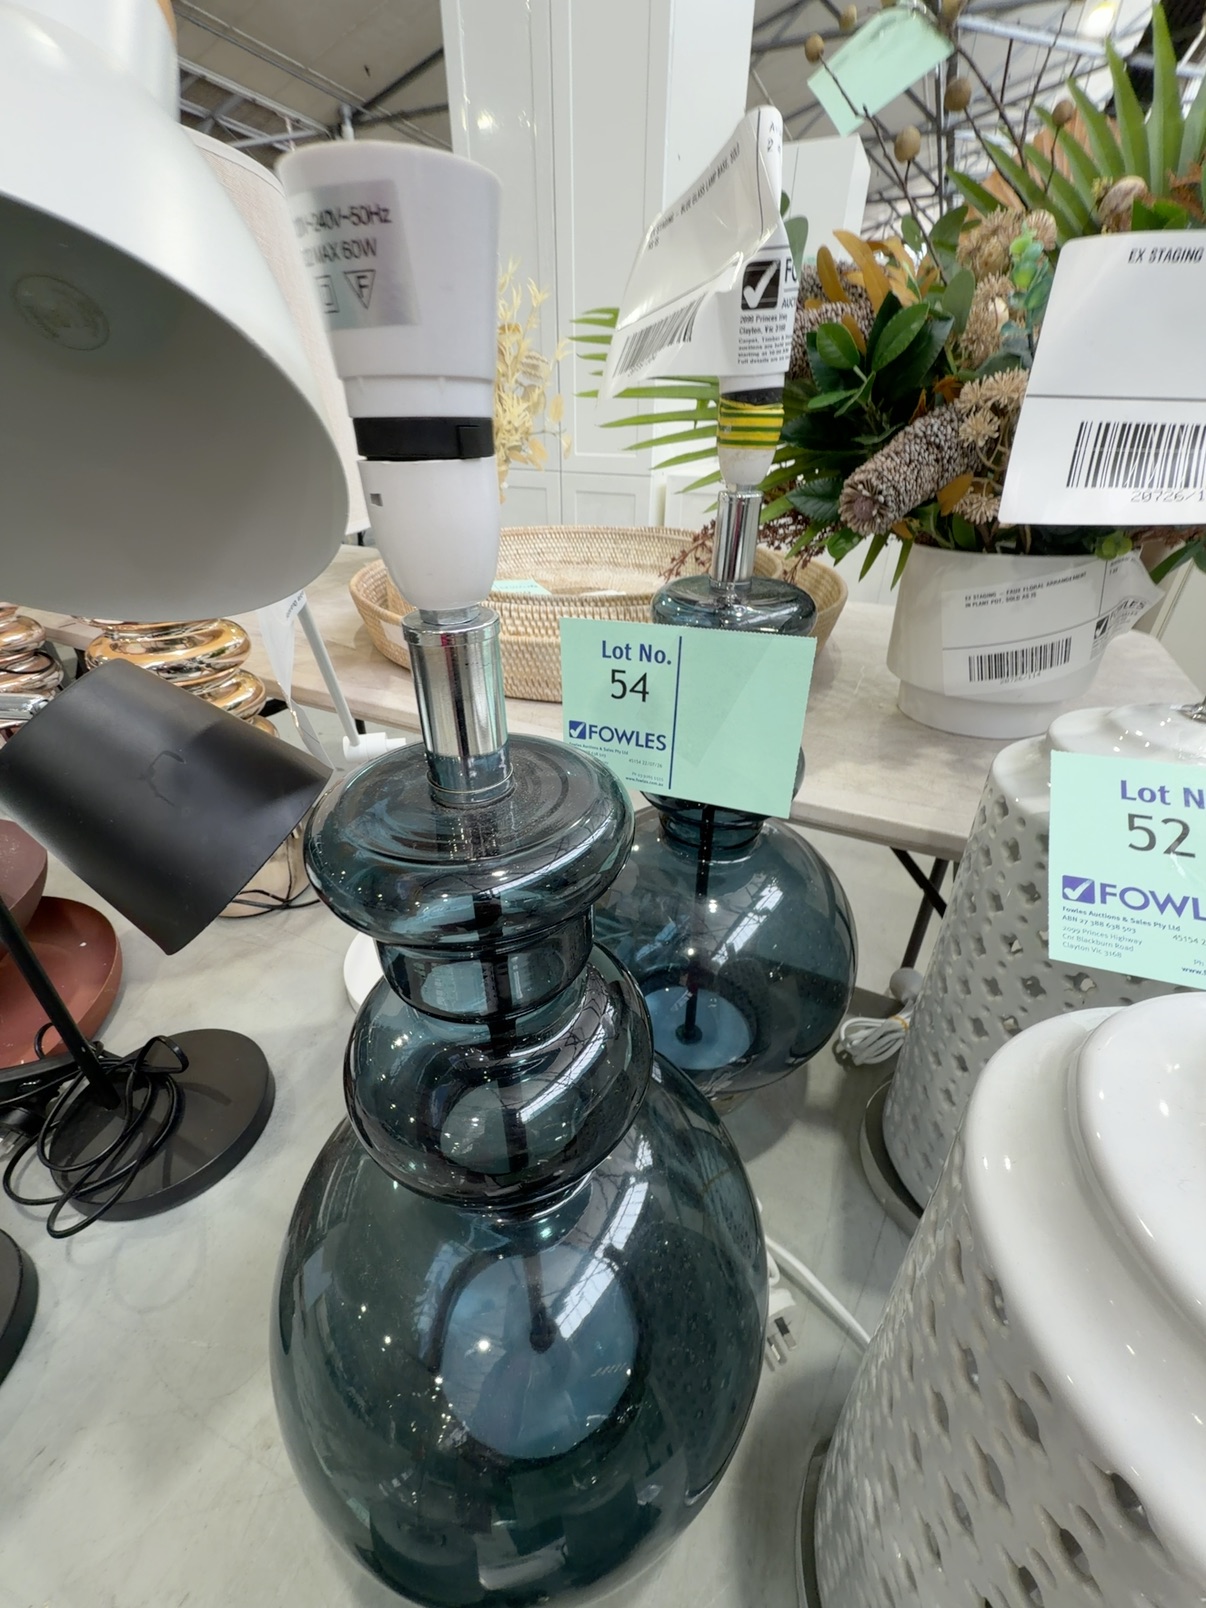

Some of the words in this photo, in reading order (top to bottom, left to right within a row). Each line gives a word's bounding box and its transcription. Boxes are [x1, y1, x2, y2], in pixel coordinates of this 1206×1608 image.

[342, 237, 377, 260] 60W
[1128, 247, 1146, 264] EX
[1149, 246, 1205, 264] STAGING
[756, 314, 777, 323] Princes
[973, 590, 997, 601] STAGING
[1023, 583, 1044, 592] FLORAL
[1046, 571, 1087, 588] ARRANGEMENT
[972, 599, 990, 608] PLANT
[1005, 595, 1021, 603] SOLD
[602, 640, 632, 661] Lot
[639, 643, 672, 665] No.
[610, 668, 650, 702] 54
[588, 724, 667, 751] FOWLES
[1120, 779, 1172, 806] Lot
[1127, 813, 1196, 859] 52
[1100, 882, 1206, 922] FOWL
[1062, 905, 1087, 916] Fowles
[1088, 910, 1120, 921] Auctions
[1130, 917, 1152, 927] Sales
[1153, 921, 1167, 931] Pty
[1168, 924, 1181, 932] Ltd
[1062, 914, 1078, 922] ABN
[1090, 919, 1104, 928] 388
[1106, 922, 1121, 931] 638
[1122, 925, 1137, 934] 503
[1062, 926, 1081, 935] 2099
[1082, 928, 1109, 939] Princes
[1110, 932, 1143, 946] Highway
[1062, 933, 1075, 941] Cnr
[1077, 935, 1113, 948] Blackburn
[1114, 942, 1134, 952] Road
[1172, 934, 1199, 944] 45154
[1062, 941, 1090, 953] Clayton
[1091, 946, 1102, 955] Vic
[1104, 949, 1122, 959] 3168
